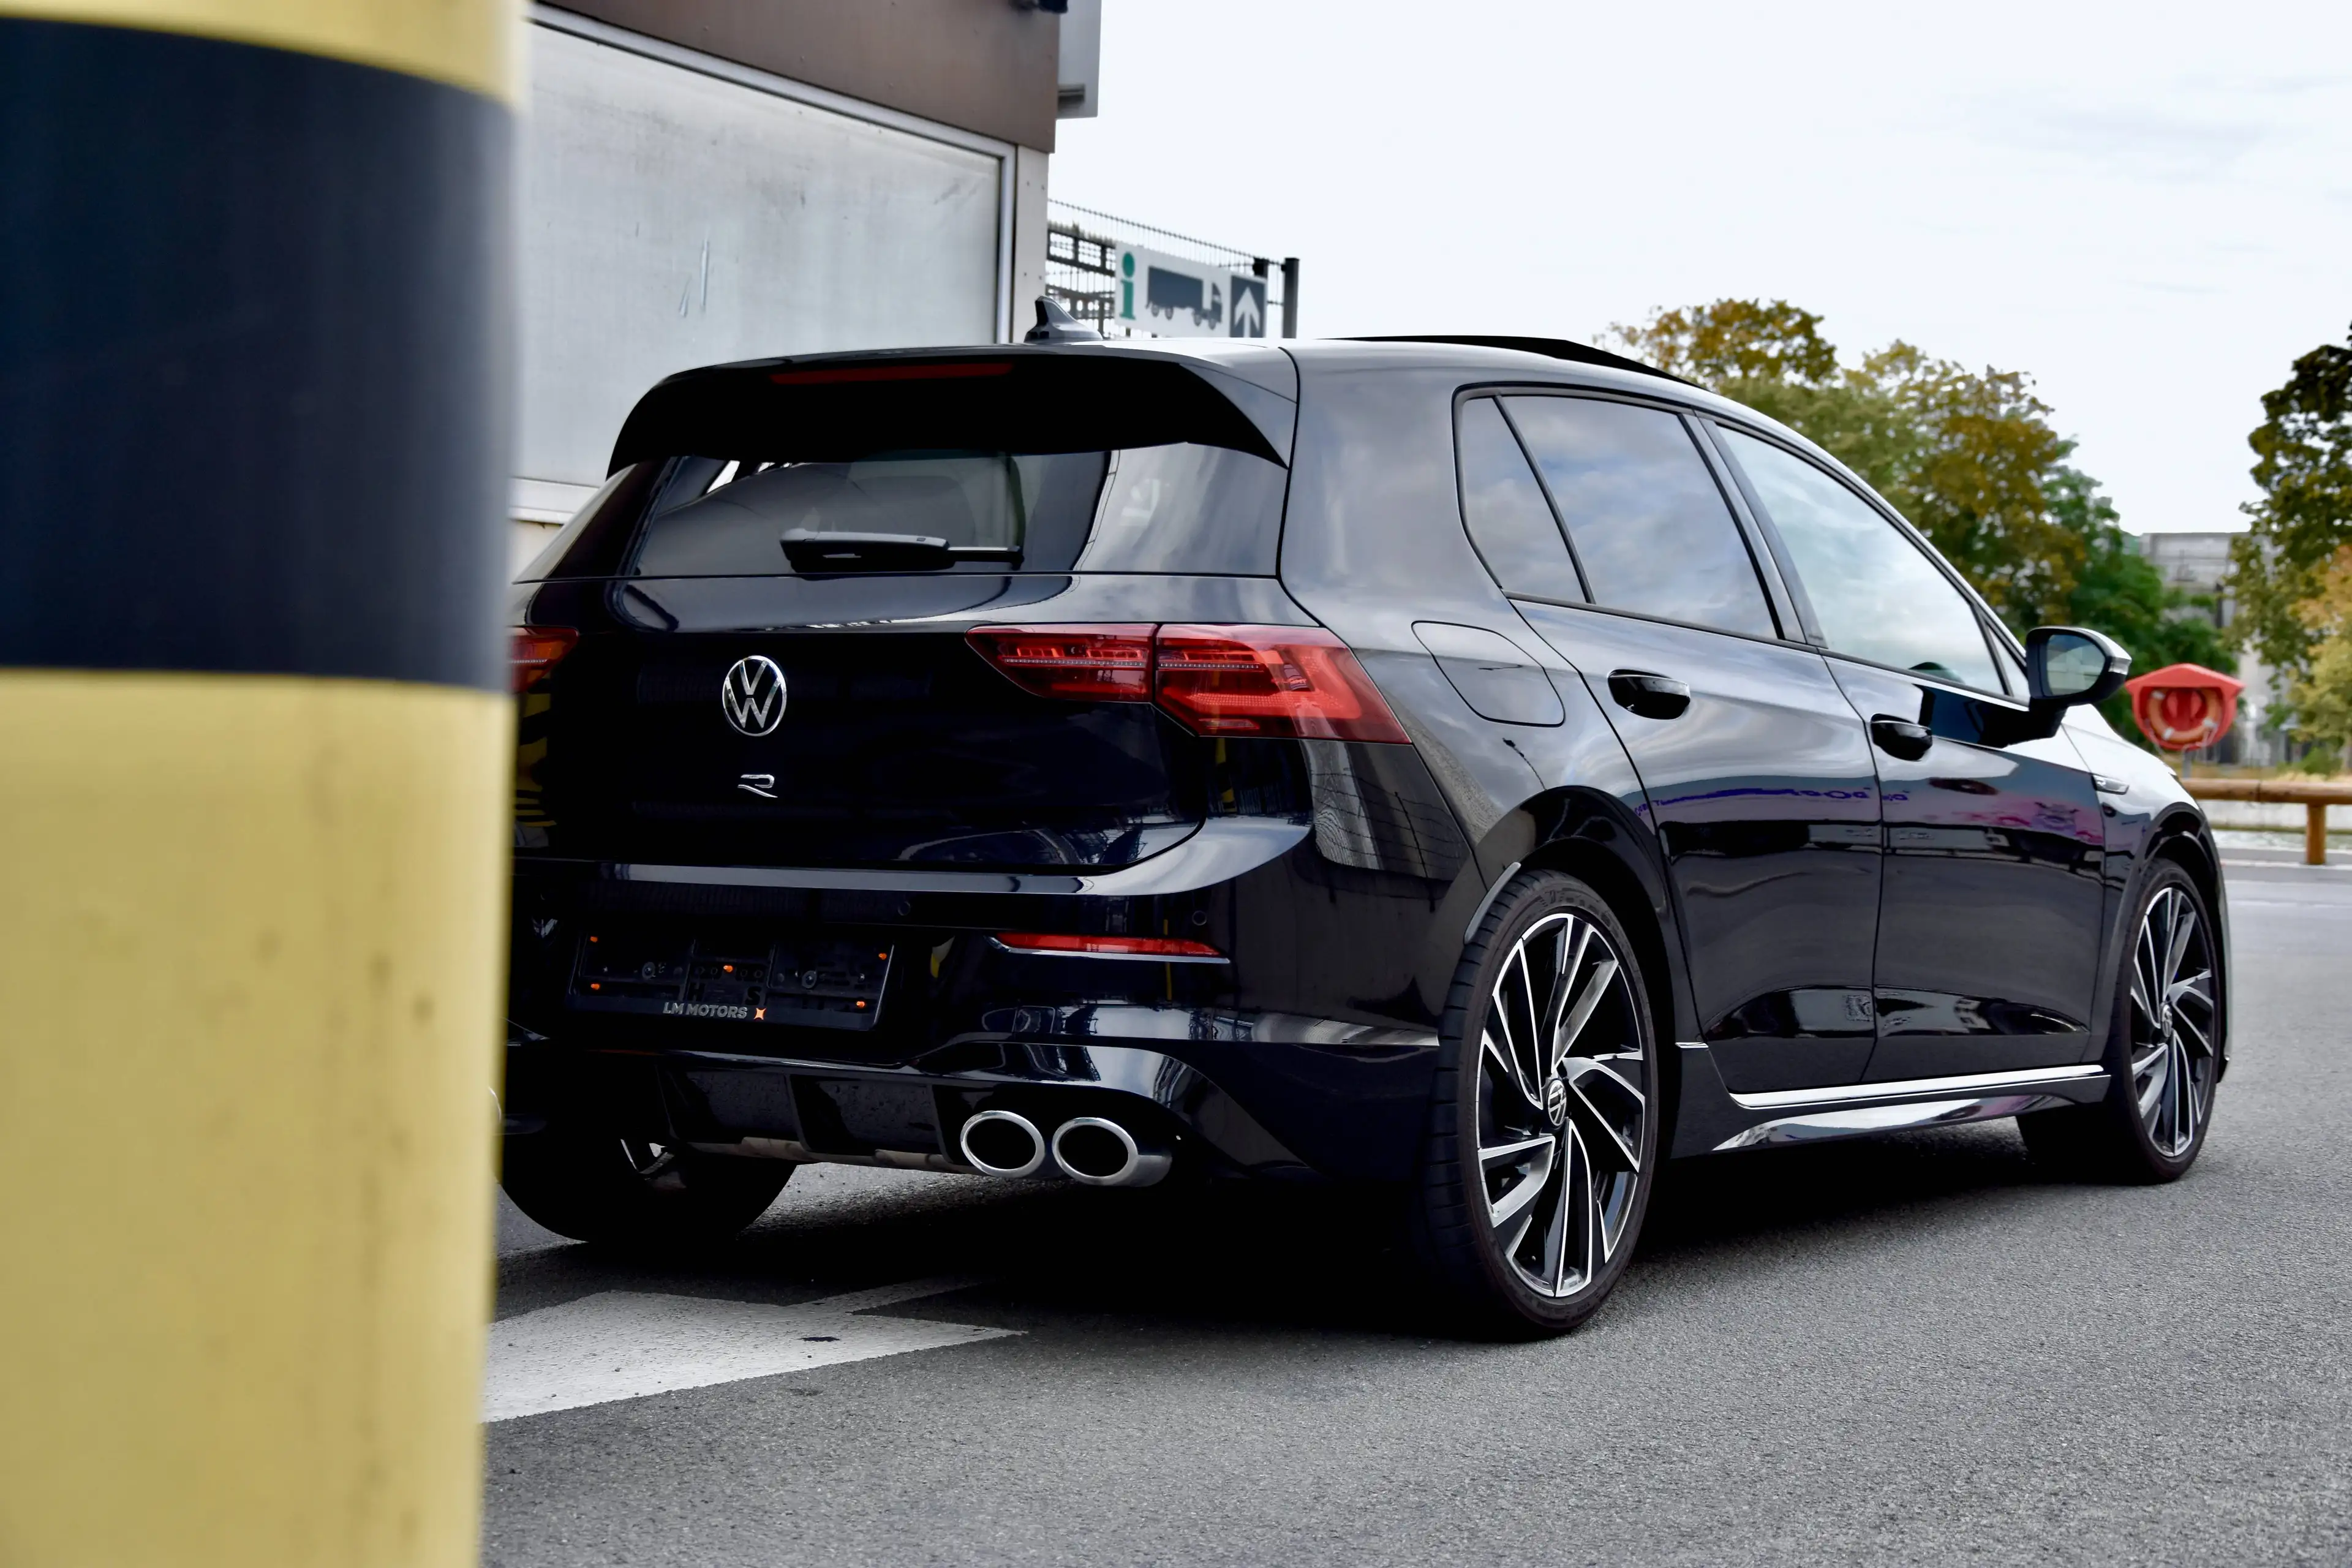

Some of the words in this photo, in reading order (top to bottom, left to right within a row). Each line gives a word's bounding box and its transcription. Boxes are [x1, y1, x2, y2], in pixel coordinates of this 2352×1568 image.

[1120, 252, 1136, 320] i
[737, 774, 778, 798] R
[663, 1002, 684, 1015] LM
[685, 1004, 748, 1019] MOTORS
